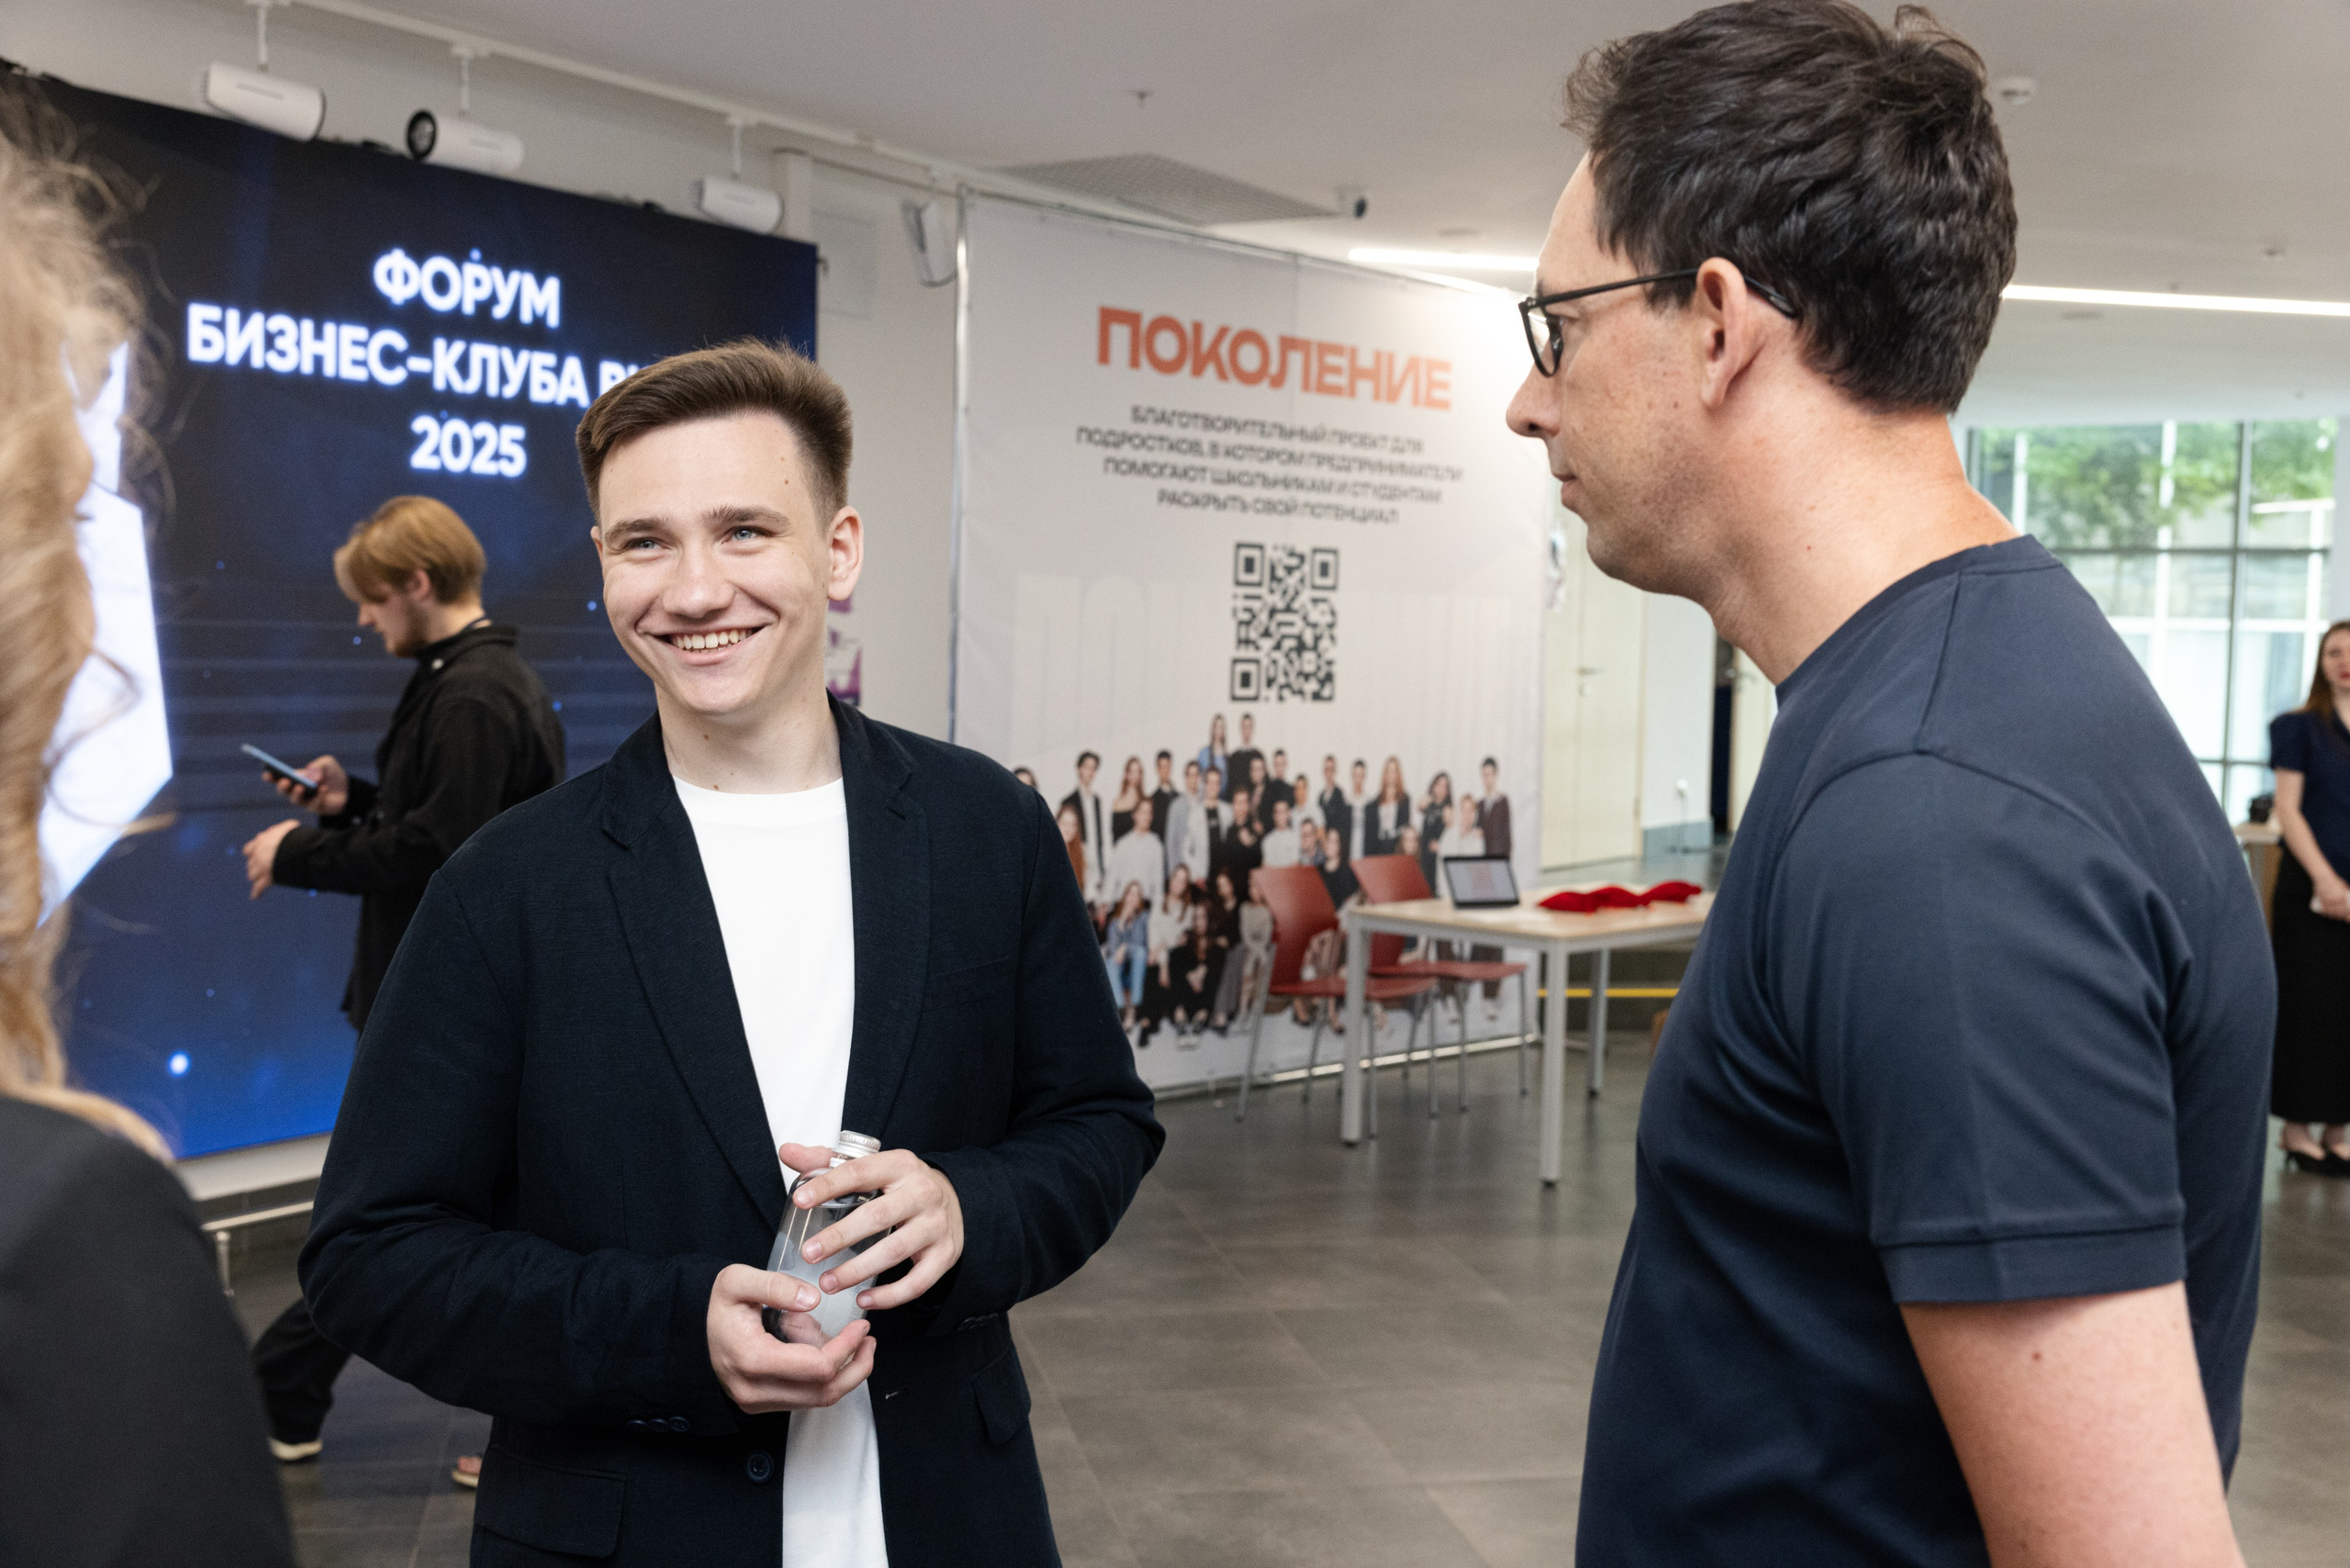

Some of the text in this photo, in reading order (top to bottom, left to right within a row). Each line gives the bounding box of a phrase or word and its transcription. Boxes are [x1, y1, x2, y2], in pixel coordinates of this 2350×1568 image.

[373, 248, 561, 329] ФОРУМ
[187, 303, 591, 409] БИЗНЕС-КЛУБА
[1097, 306, 1452, 410] ПОКОЛЕНИЕ
[410, 415, 527, 476] 2025
[1130, 405, 1326, 443] БЛАГОТВОРИТЕЛЬНЫЙ
[1103, 456, 1208, 483] ПОМОГАЮТ
[1158, 488, 1248, 514] РАСКРЫТЬ
[1252, 497, 1299, 518] СВОЙ
